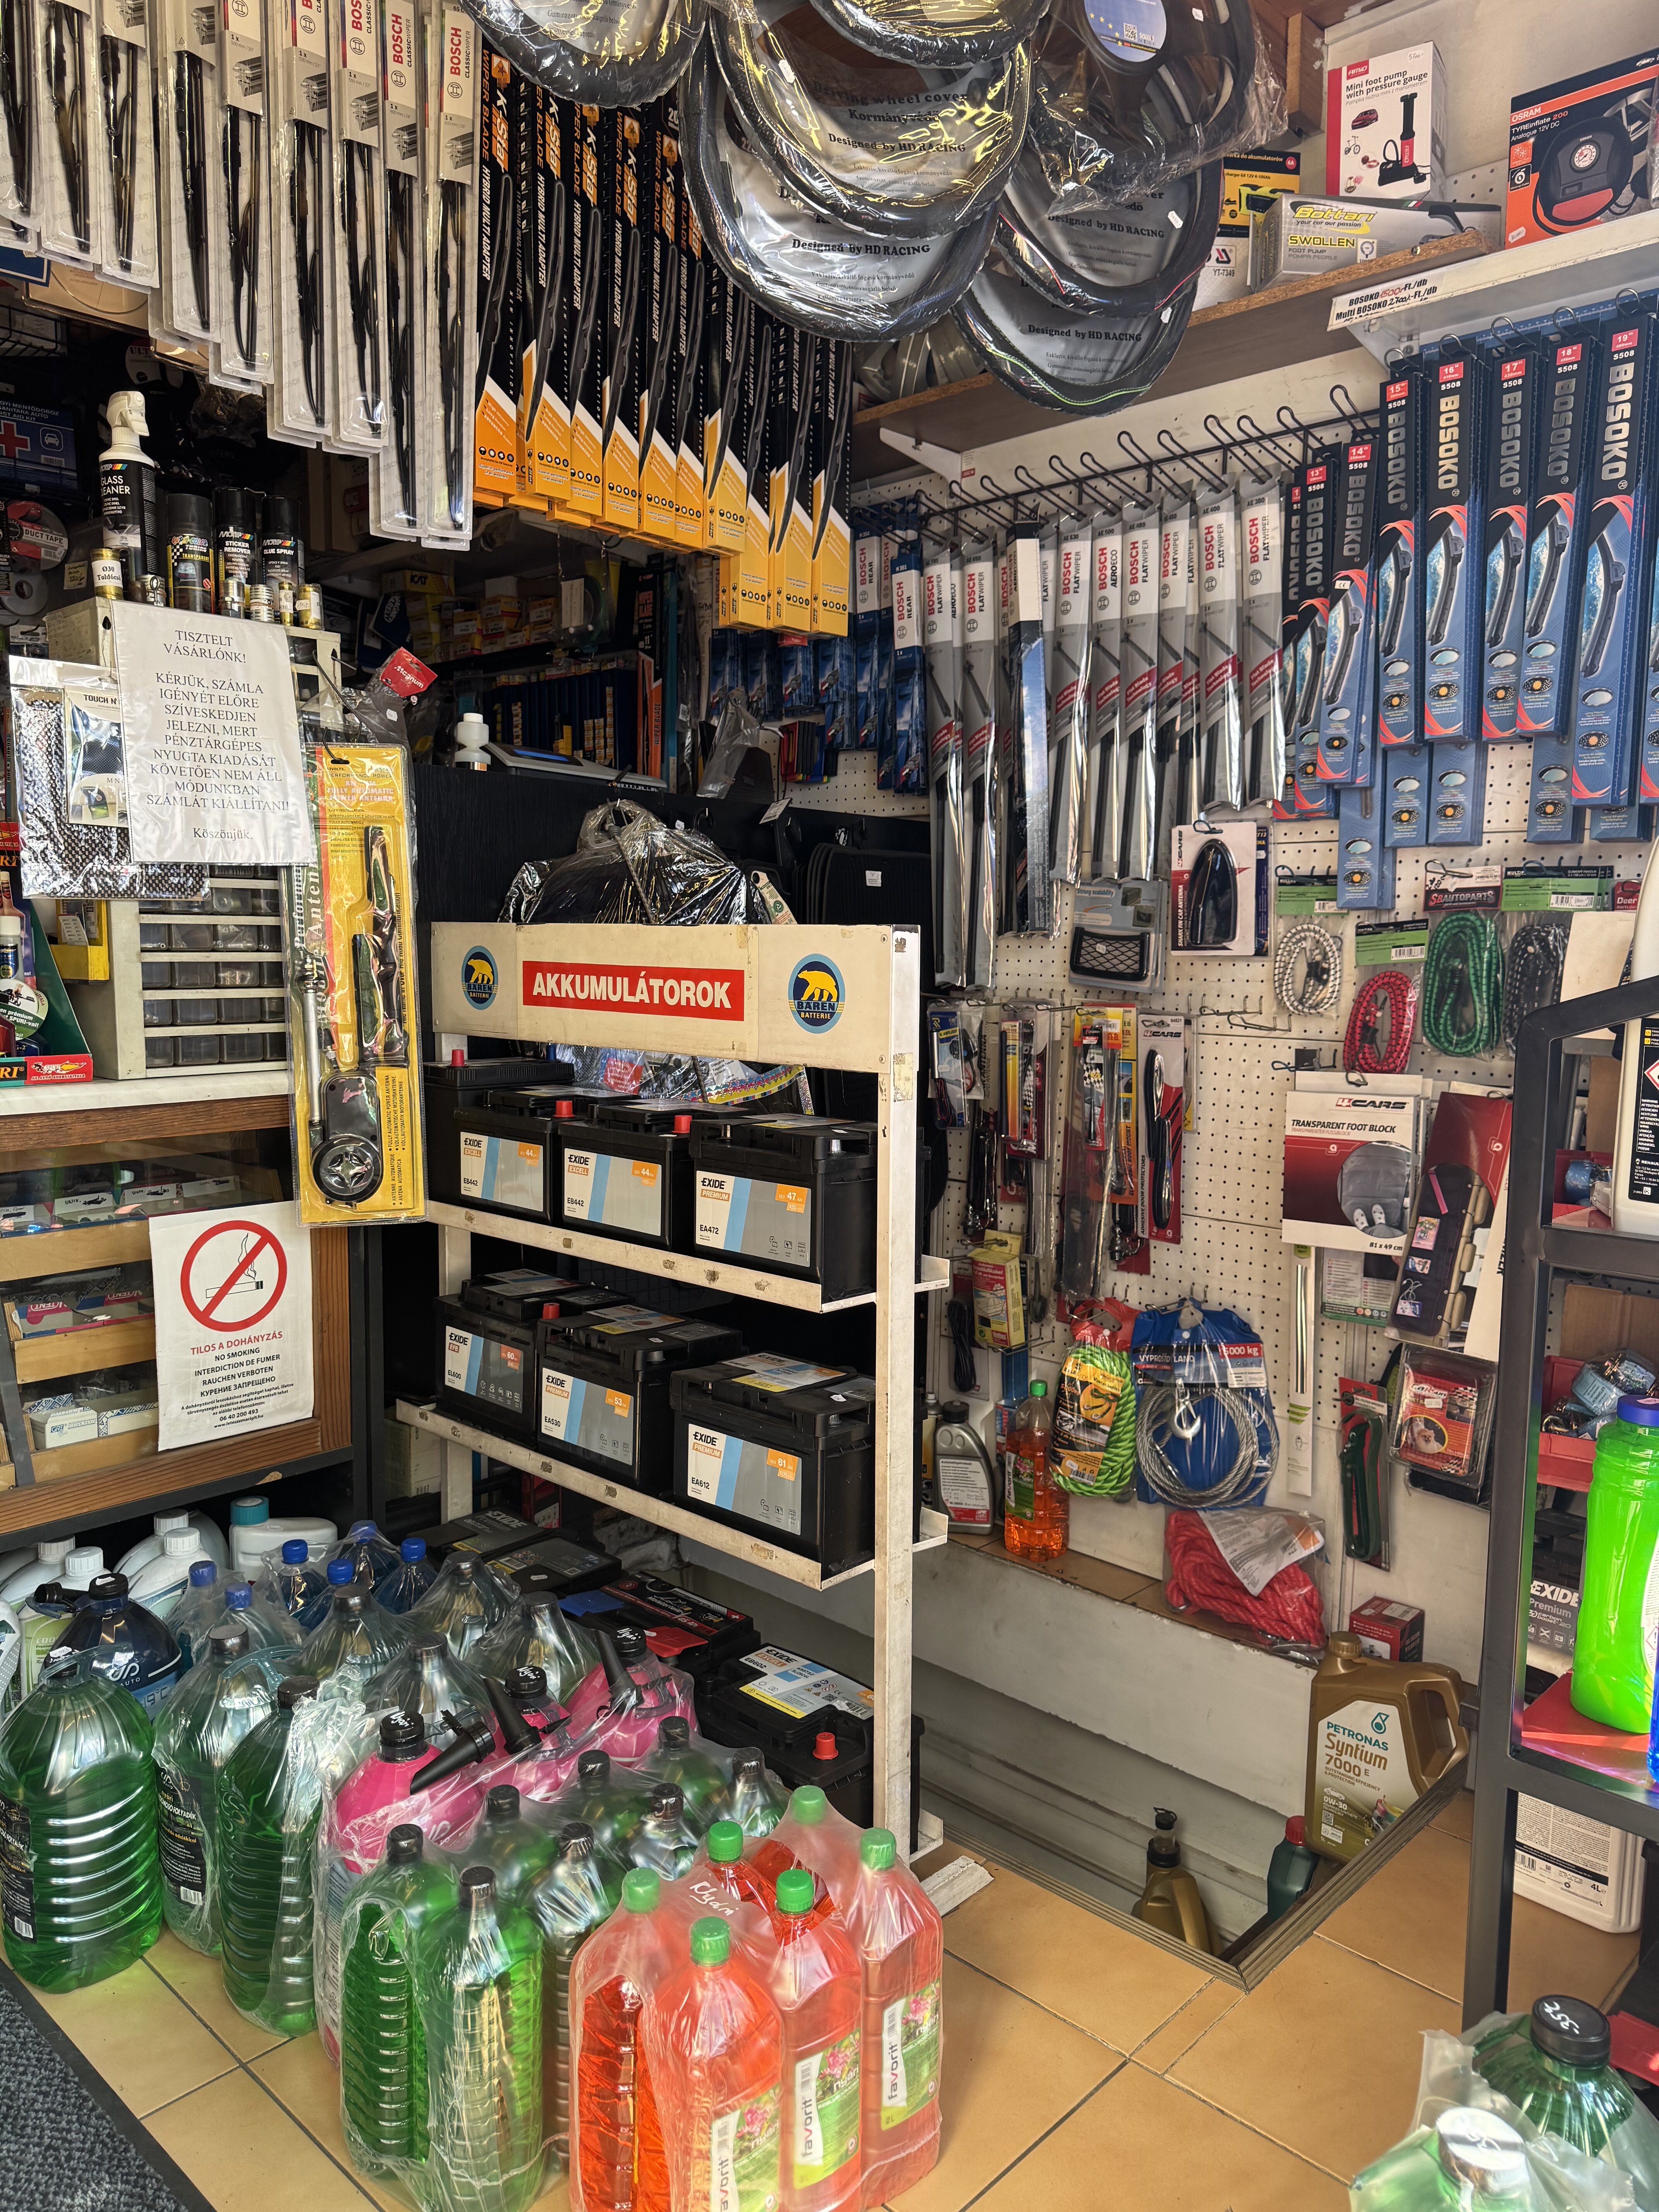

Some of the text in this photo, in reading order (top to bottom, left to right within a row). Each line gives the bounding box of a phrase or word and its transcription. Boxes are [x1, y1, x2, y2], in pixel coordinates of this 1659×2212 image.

[392, 14, 404, 65] BOSCH
[450, 27, 461, 76] BOSCH
[1346, 70, 1407, 92] Mini foot pump
[1346, 72, 1428, 99] with pressure gauge
[872, 94, 920, 104] wheel
[1346, 80, 1427, 106] Pompka manometrem
[1512, 106, 1541, 122] OSRAM
[1511, 110, 1568, 134] TYREinflate 200
[1511, 120, 1560, 142] Analogue 12V DC
[828, 133, 882, 149] Designed
[1293, 206, 1377, 222] Bottari
[1125, 226, 1165, 238] RACING
[793, 239, 930, 256] Designed by HD RACING
[1288, 235, 1355, 248] SWOLLEN
[1213, 269, 1235, 277] YT-7349
[1349, 292, 1379, 306] BOSOKO
[1336, 308, 1355, 320] Multi
[1357, 300, 1387, 315] BOSOKO
[1441, 381, 1461, 390] S508
[1388, 399, 1406, 409] S508
[1438, 395, 1460, 489] BOSOKO
[1388, 411, 1406, 504] BOSOKO
[101, 476, 123, 484] GLASS
[25, 529, 64, 544] DUCT TAPE
[224, 547, 251, 555] REMOVER
[175, 630, 233, 646] TISZTELT
[163, 642, 246, 663] VÁSÁRLÓNK!
[156, 672, 264, 694] KÉRJÜK, SZÁMLA
[83, 694, 108, 703] TOUCH
[160, 688, 259, 708] IGÉNYÉT ELŐRE
[165, 704, 256, 722] SZÍVESKEDJEN
[167, 720, 257, 737] JELEZNI, MERT
[165, 733, 262, 752] PÉNZTÁRGÉPES
[153, 749, 276, 766] NYUGTA KIADÁSÁT
[151, 763, 282, 781] KÖVETŐEN NEM ÁLL
[175, 780, 259, 795] MÓDUNKBAN
[147, 793, 289, 811] SZÁMLÁT KIÁLLÍTANI!
[193, 828, 252, 841] Köszönjük.
[466, 983, 493, 993] BÄREN
[532, 971, 732, 1009] AKKUMULÁTOROK
[797, 1001, 835, 1012] BÄREN
[8, 1010, 33, 1020] prémium
[800, 1012, 831, 1020] BATTERIE
[1143, 1030, 1182, 1038] 4CARS
[1335, 1098, 1407, 1109] 4CARS
[1291, 1120, 1346, 1130] TRANSPARENT
[1369, 1124, 1396, 1133] BLOCK
[464, 1138, 483, 1148] EXIDE
[568, 1154, 590, 1165] EXIDE
[569, 1166, 588, 1175] EXCELL
[464, 1178, 478, 1186] EB442
[701, 1178, 725, 1190] EXIDE
[567, 1197, 584, 1207] EB442
[702, 1190, 728, 1200] PREMIUM
[787, 1192, 796, 1200] 47
[700, 1224, 719, 1234] EA472
[191, 1344, 216, 1355] TILOS
[227, 1331, 283, 1348] DOHÁNYZÁS
[227, 1347, 260, 1359] SMOKING
[507, 1352, 514, 1360] 60
[1247, 1346, 1259, 1356] kg
[195, 1361, 244, 1377] INTERDICTION
[256, 1354, 280, 1364] FUMER
[203, 1366, 273, 1386] RAUCHEN VERBOTEN
[448, 1370, 461, 1380] EL600
[201, 1376, 276, 1398] КУРЕНИЕ ЗАПРЕЩЕНО
[547, 1386, 568, 1398] PREMIUM
[185, 1399, 215, 1410] dohányzásról
[614, 1397, 622, 1406] 53
[544, 1416, 561, 1427] EA530
[694, 1444, 720, 1458] PREMIUM
[778, 1458, 786, 1468] 61
[692, 1477, 710, 1489] EA612
[1530, 1597, 1571, 1618] Premium
[744, 1656, 767, 1669] EB602
[1327, 1721, 1389, 1751] PETRONAS
[1325, 1732, 1388, 1771] Syntium
[1325, 1753, 1370, 1777] 7000 E
[1325, 1766, 1355, 1782] OUTSTANDING
[1328, 1772, 1355, 1786] PROTECTION
[1324, 1796, 1348, 1810] 0W-30
[888, 2043, 898, 2100] favorit
[802, 2099, 812, 2158] favorit
